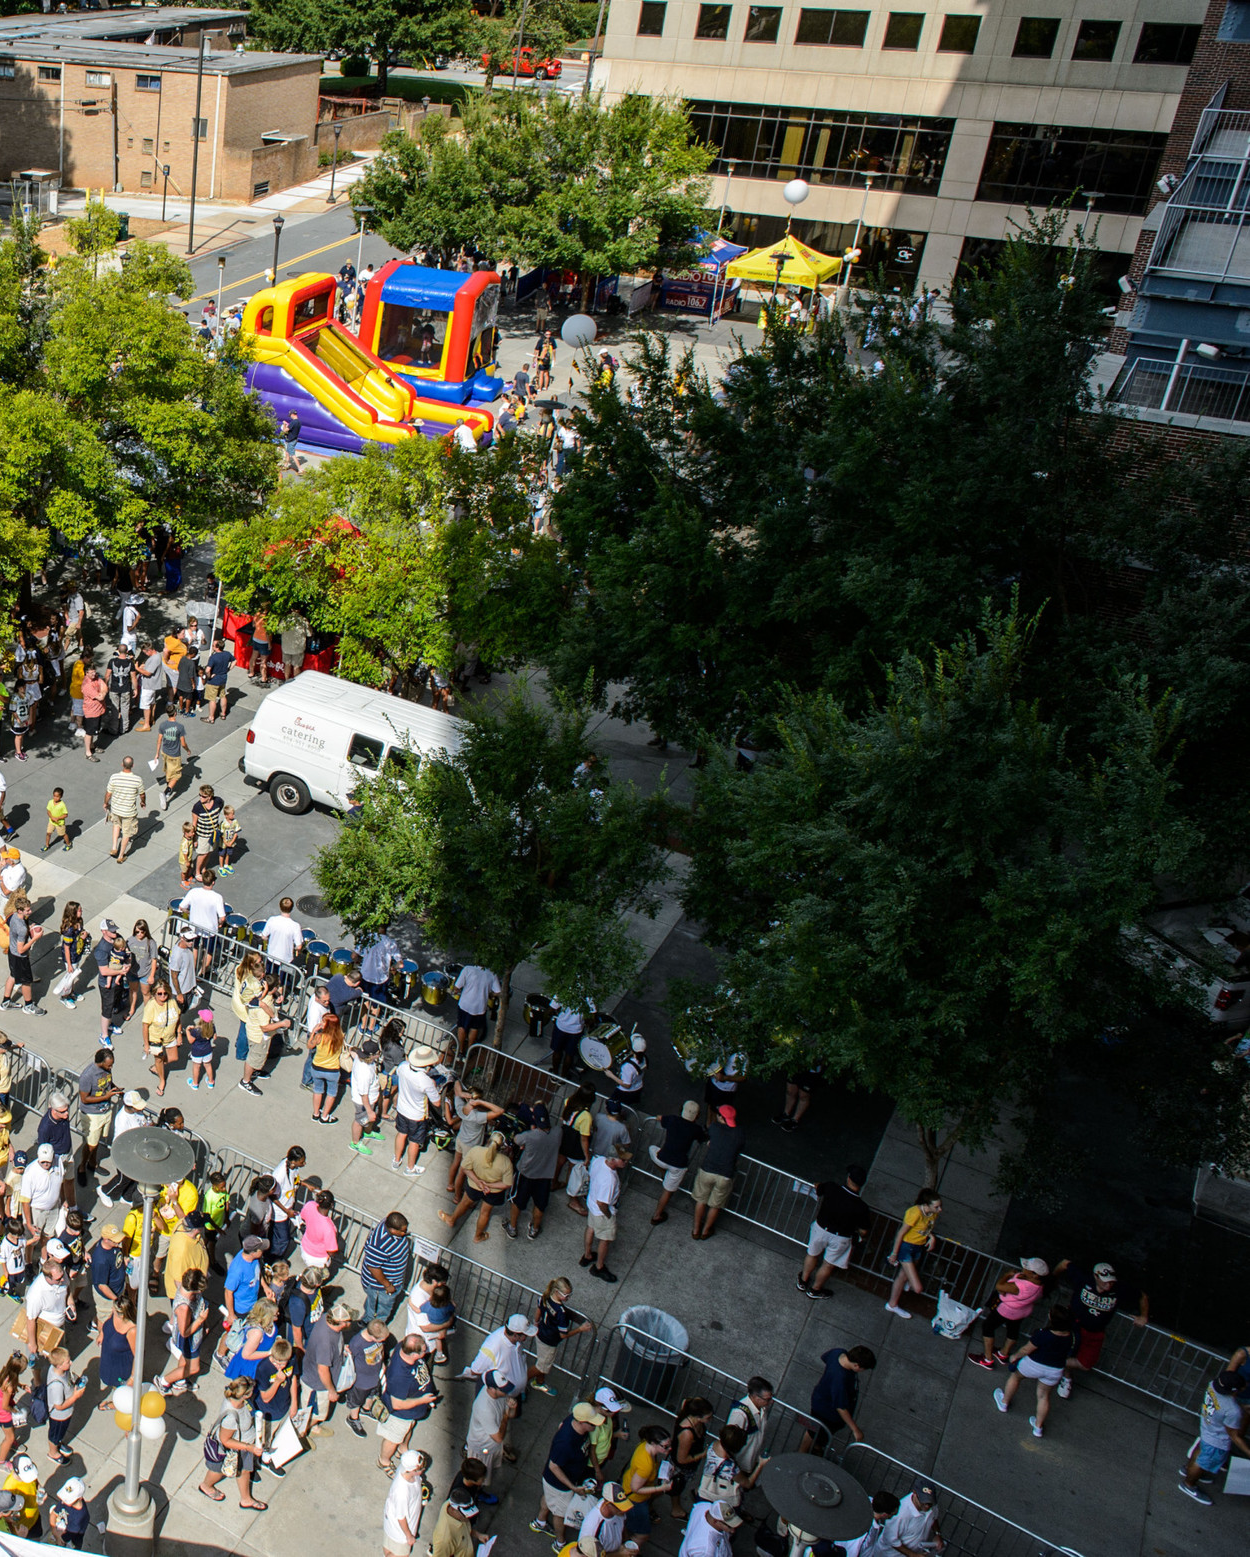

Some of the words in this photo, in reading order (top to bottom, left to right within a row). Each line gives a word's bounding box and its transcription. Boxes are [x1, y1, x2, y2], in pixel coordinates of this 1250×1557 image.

[665, 298, 686, 307] RADIO
[687, 297, 706, 307] 106.7
[281, 726, 326, 749] catering
